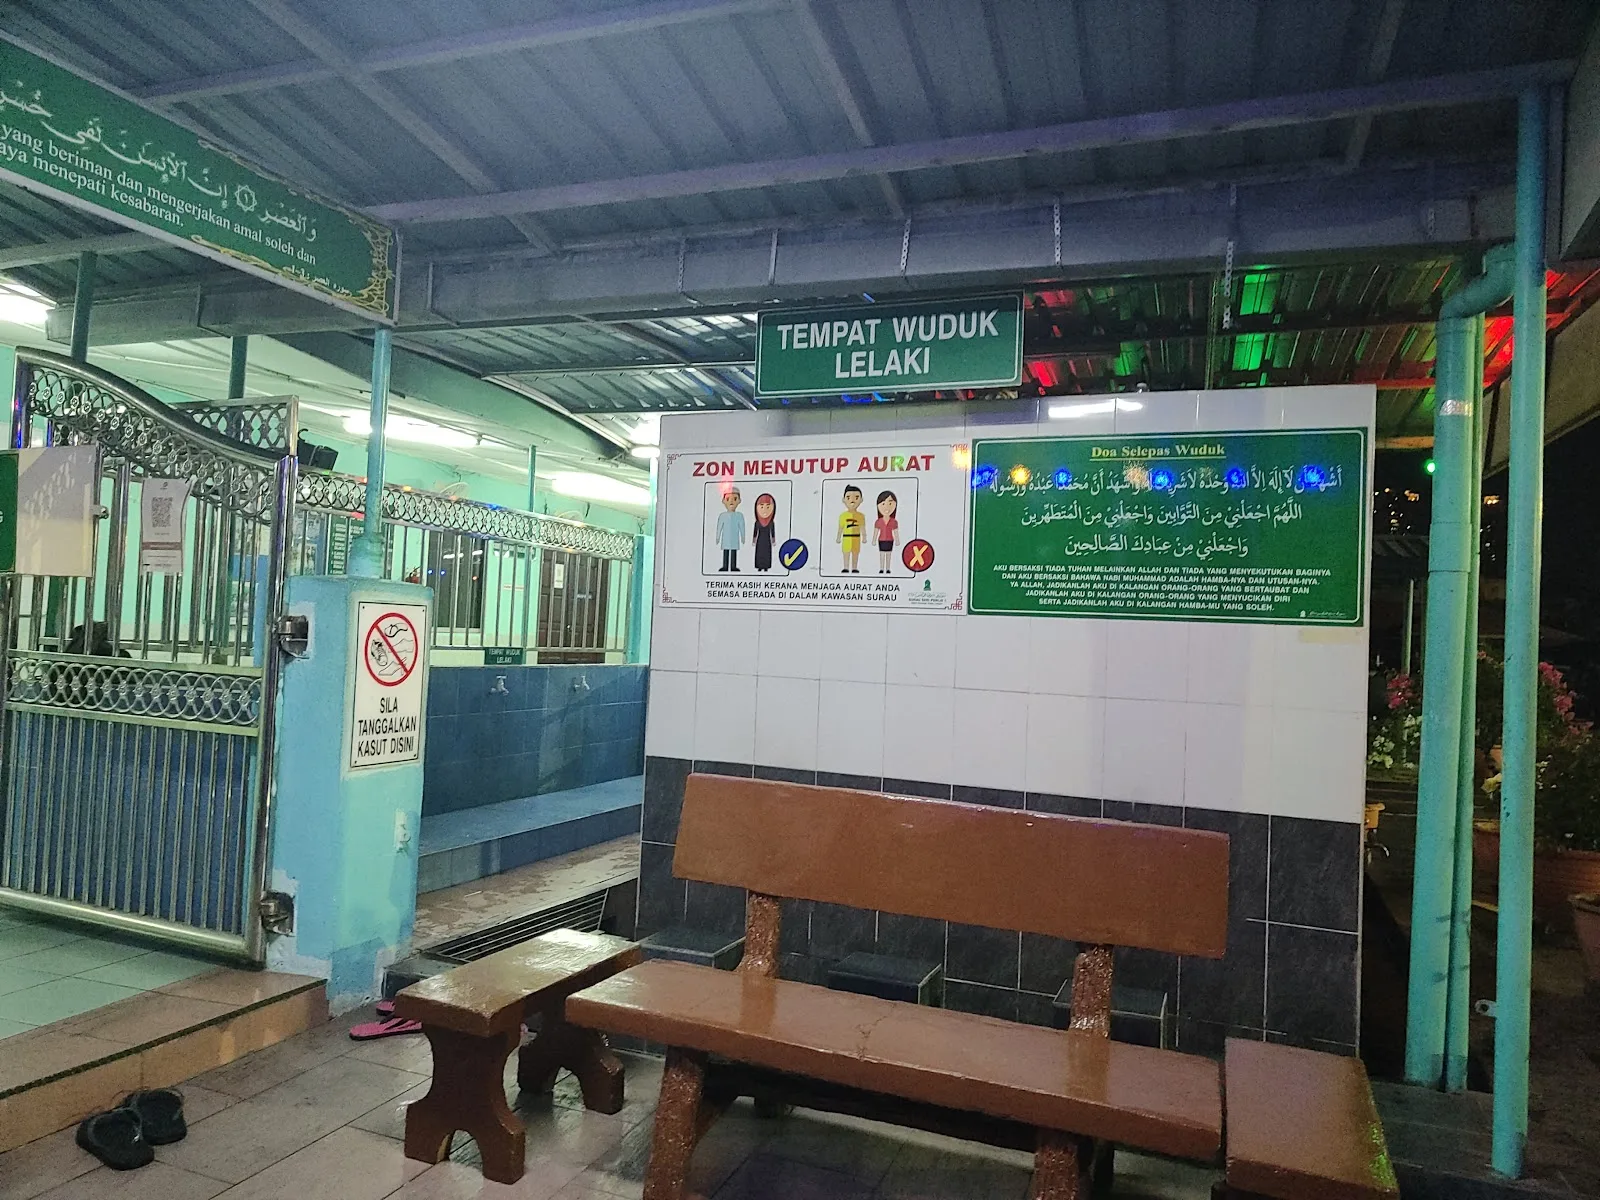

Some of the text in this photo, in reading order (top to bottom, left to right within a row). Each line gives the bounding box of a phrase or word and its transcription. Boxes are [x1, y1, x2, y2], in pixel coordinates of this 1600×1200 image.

[1, 124, 316, 265] yang beriman dan mengerjakan amal soleh dan
[33, 156, 105, 195] menepati
[111, 184, 184, 227] kesabaran.
[777, 309, 999, 350] TEMPAT WUDUK
[835, 347, 930, 379] LELAKI
[1092, 444, 1224, 459] Doa Selepas Wuduk
[693, 455, 935, 477] ZON MENUTUP AURAT
[1230, 568, 1293, 576] MENYEKUTUKAN
[706, 581, 735, 589] TERIMA
[765, 582, 798, 590] KERANA
[844, 583, 872, 591] AURAT
[875, 584, 900, 592] ANDA
[1161, 584, 1219, 592] ORANG-ORANG
[821, 592, 863, 600] KAWASAN
[866, 593, 897, 601] SURAU
[1097, 591, 1136, 599] KALANGAN
[1139, 592, 1195, 600] ORANG-ORANG
[1221, 594, 1272, 602] MENYUCIKAN
[380, 697, 398, 714] SILA
[358, 716, 416, 736] TANGGALKAN
[357, 736, 414, 758] KASUT DISINI
